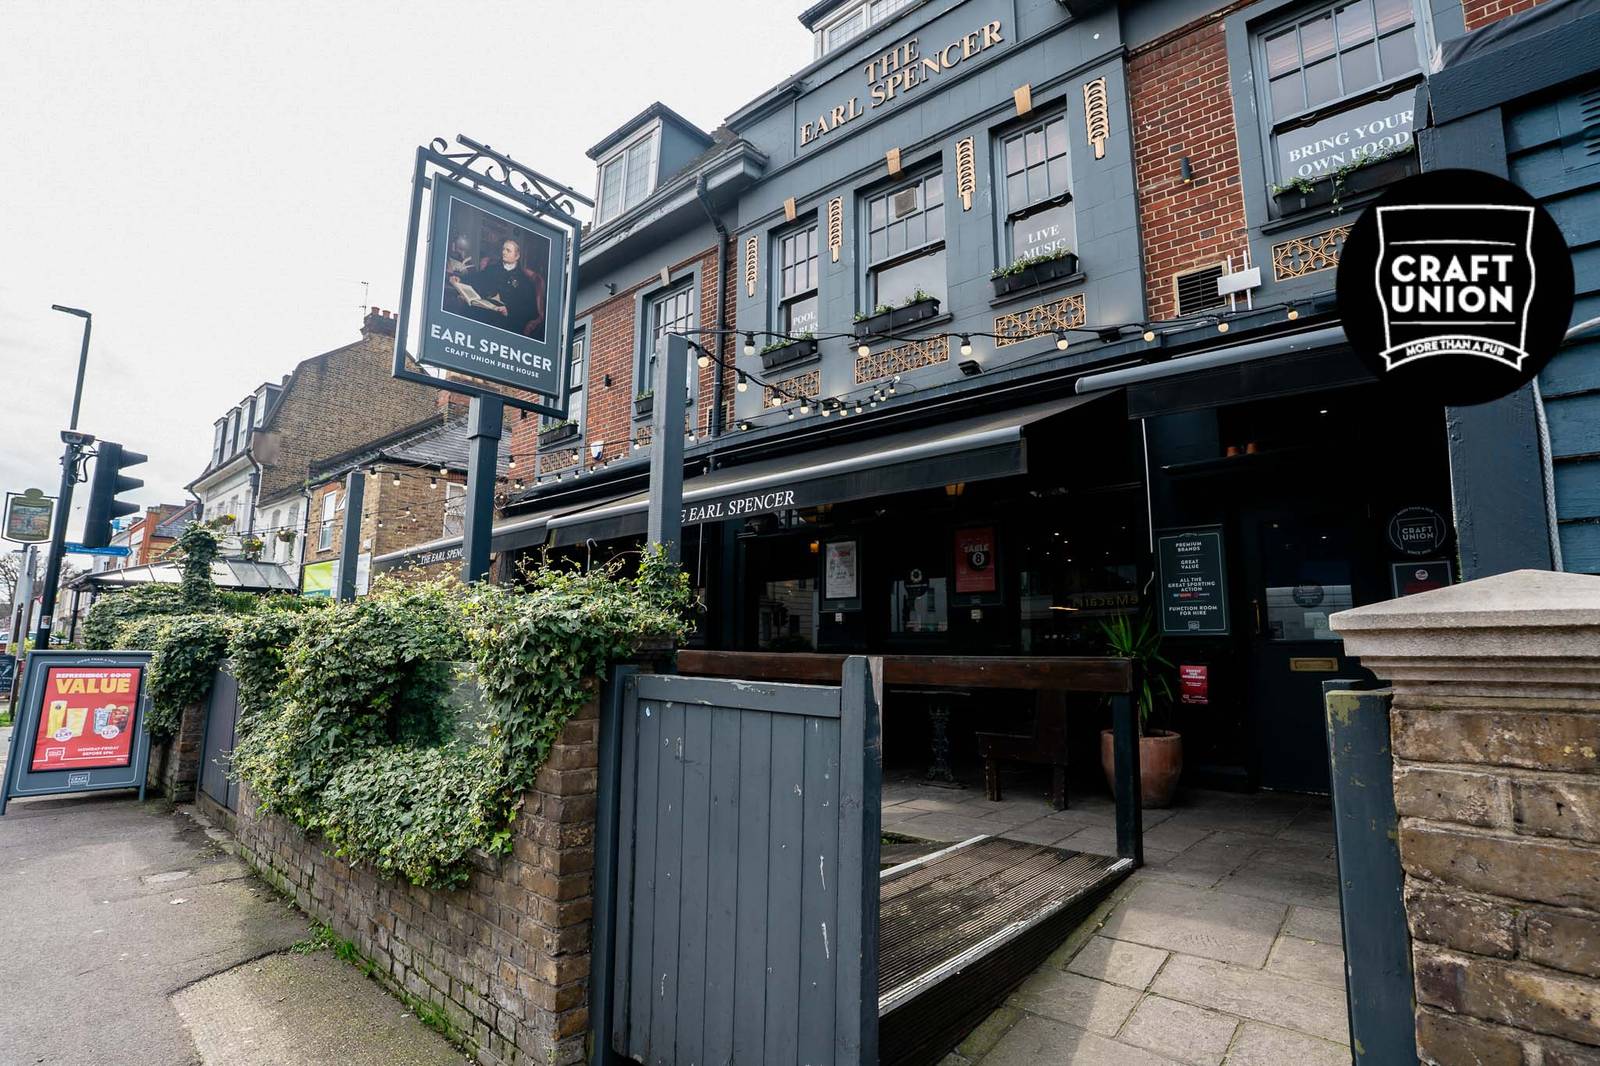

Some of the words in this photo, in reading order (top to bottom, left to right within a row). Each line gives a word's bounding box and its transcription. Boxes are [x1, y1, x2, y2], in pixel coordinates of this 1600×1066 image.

[864, 37, 920, 86] THE
[800, 96, 864, 147] EARL
[871, 20, 1004, 108] SPENCER
[1289, 132, 1350, 162] BRING
[1354, 110, 1413, 139] YOUR
[1298, 152, 1345, 177] OWN
[1349, 131, 1410, 160] FOOD
[1027, 224, 1060, 243] LIVE
[1023, 238, 1066, 259] MUSIC
[793, 311, 816, 326] POOL
[430, 323, 475, 350] EARL
[480, 339, 552, 372] SPENCER
[444, 346, 469, 360] CRAFT
[470, 353, 496, 366] UNION
[497, 360, 515, 372] FREE
[516, 366, 540, 378] HOUSE
[688, 503, 724, 522] EARL
[728, 490, 795, 515] SPENCER
[1402, 526, 1433, 534] CRAFT
[1402, 532, 1434, 541] UNION
[431, 551, 446, 562] EARL
[55, 678, 131, 694] VALUE
